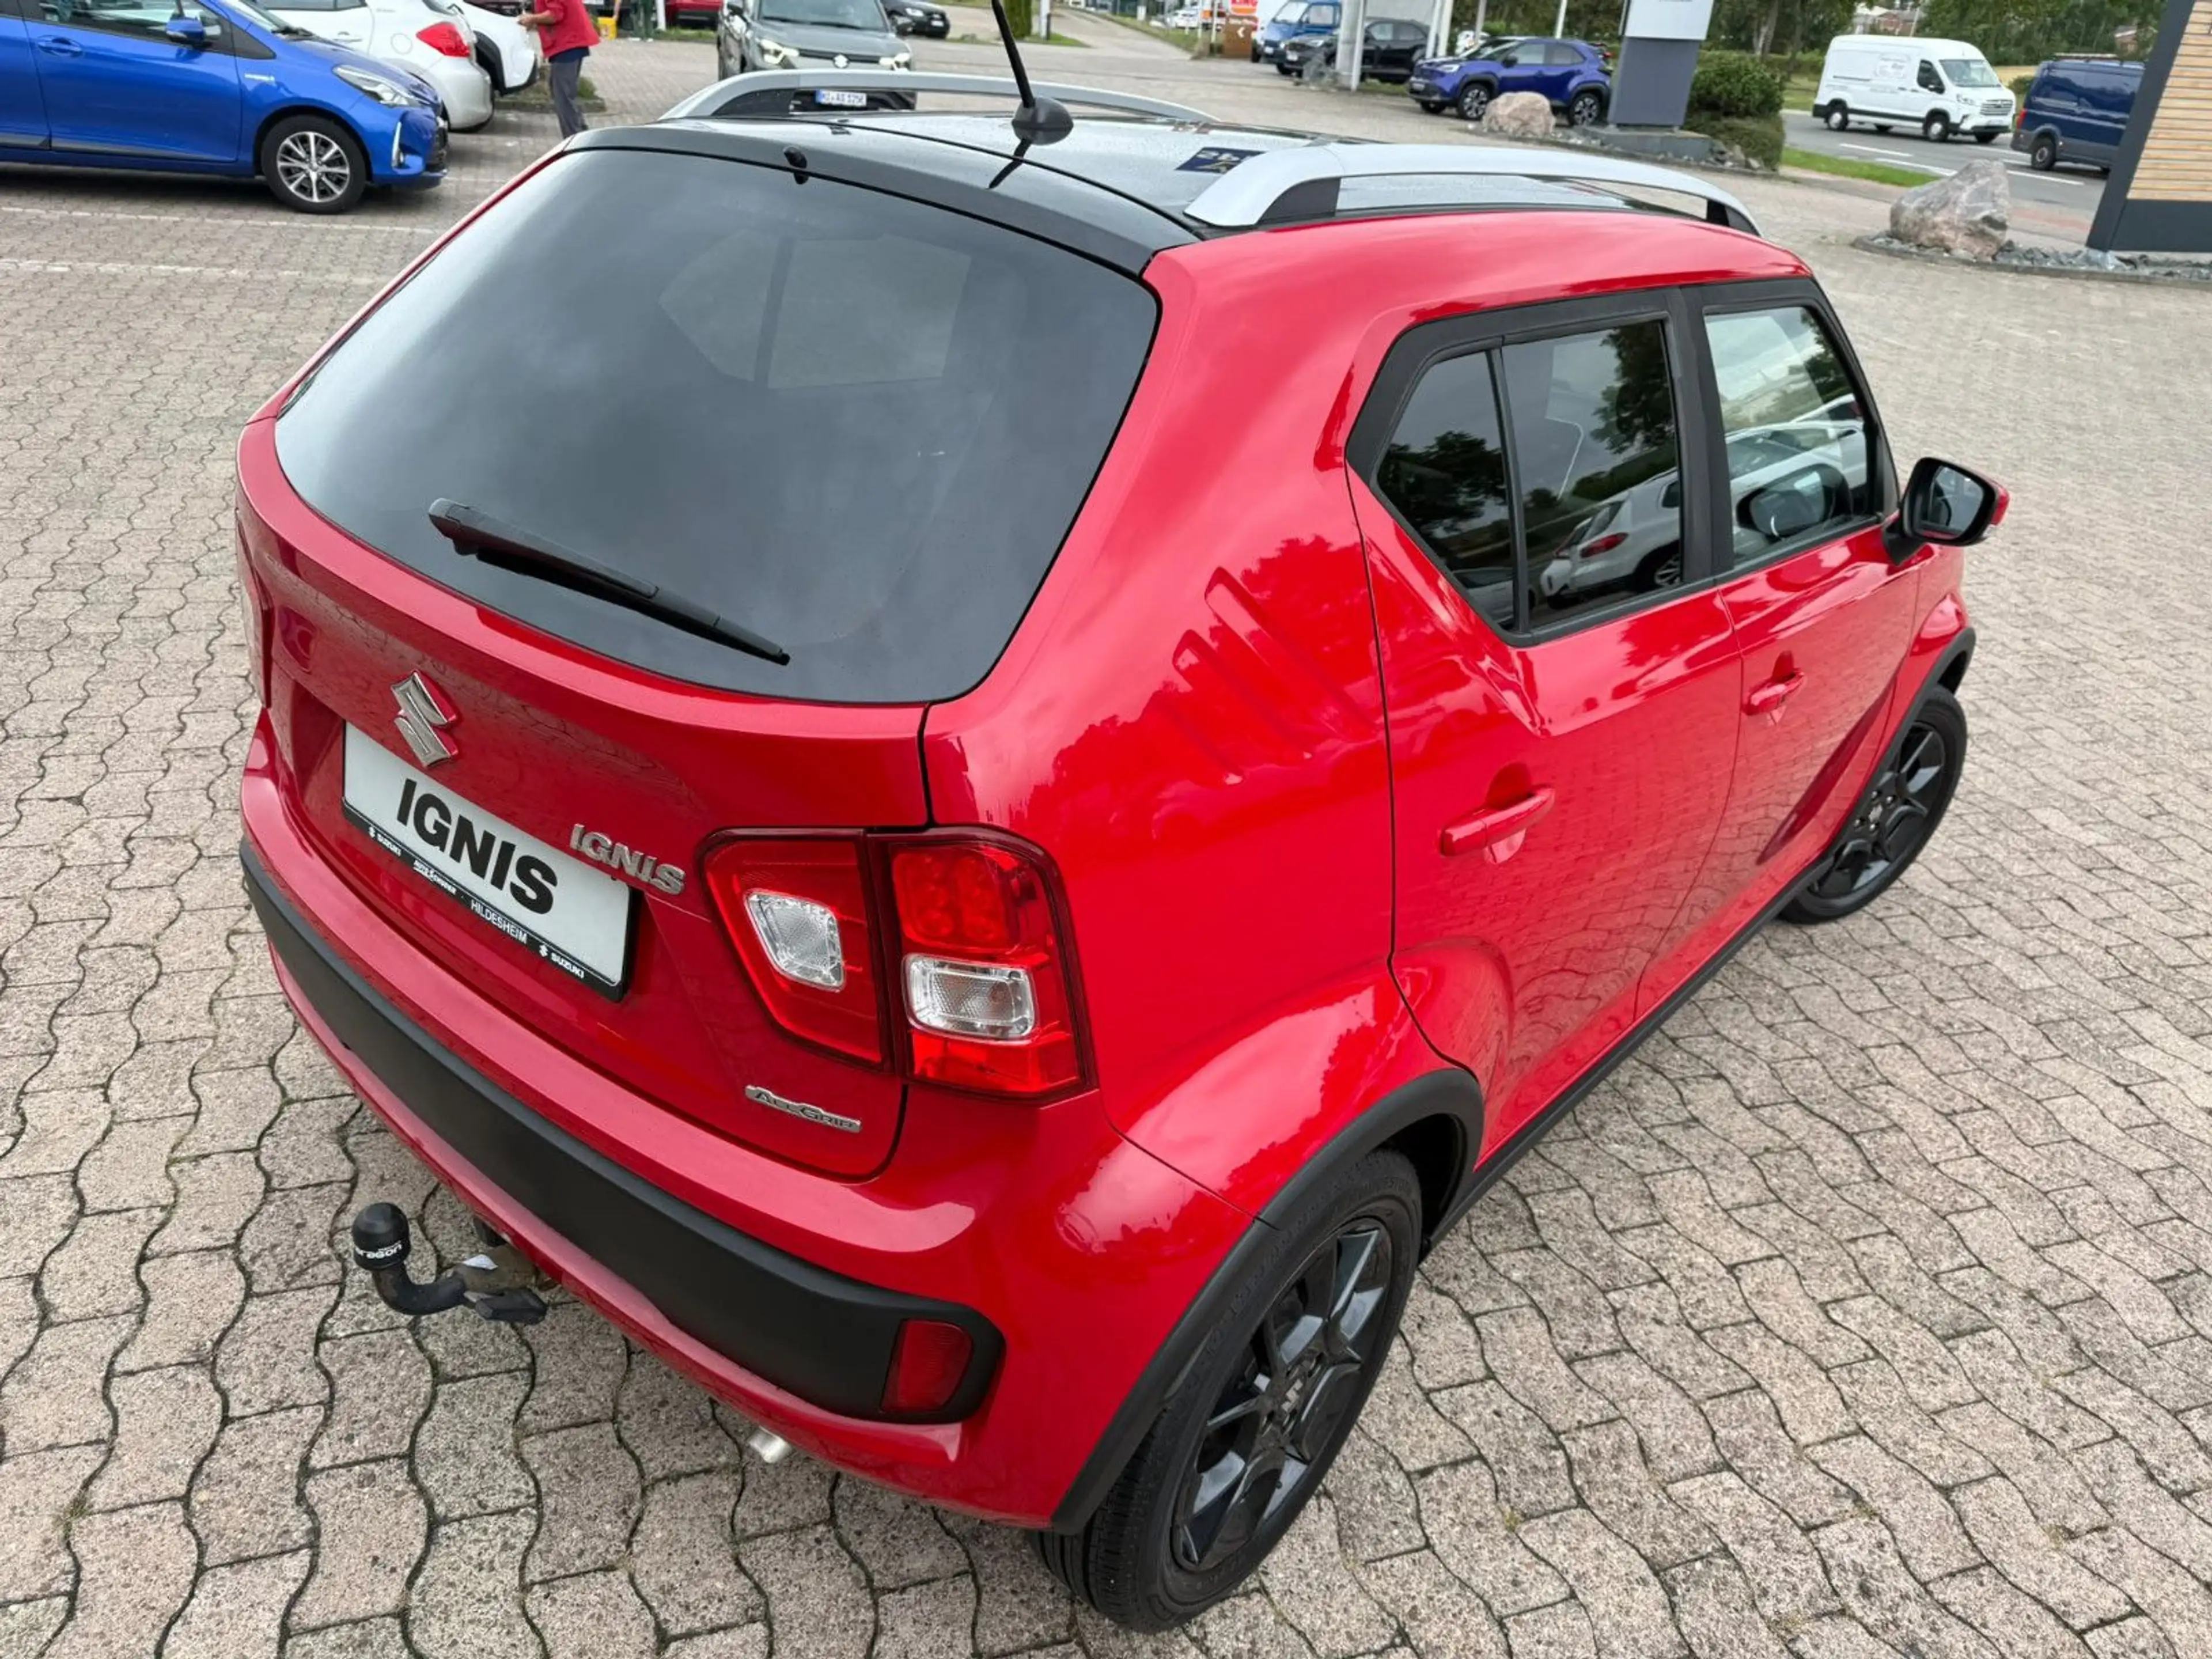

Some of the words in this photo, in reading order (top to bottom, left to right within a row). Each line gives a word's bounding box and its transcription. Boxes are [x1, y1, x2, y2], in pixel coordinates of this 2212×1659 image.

[397, 778, 558, 914] IGNIS
[570, 823, 686, 895] IGNIS
[471, 899, 528, 944] HILDESHEIM
[551, 952, 584, 979] SUZUKI
